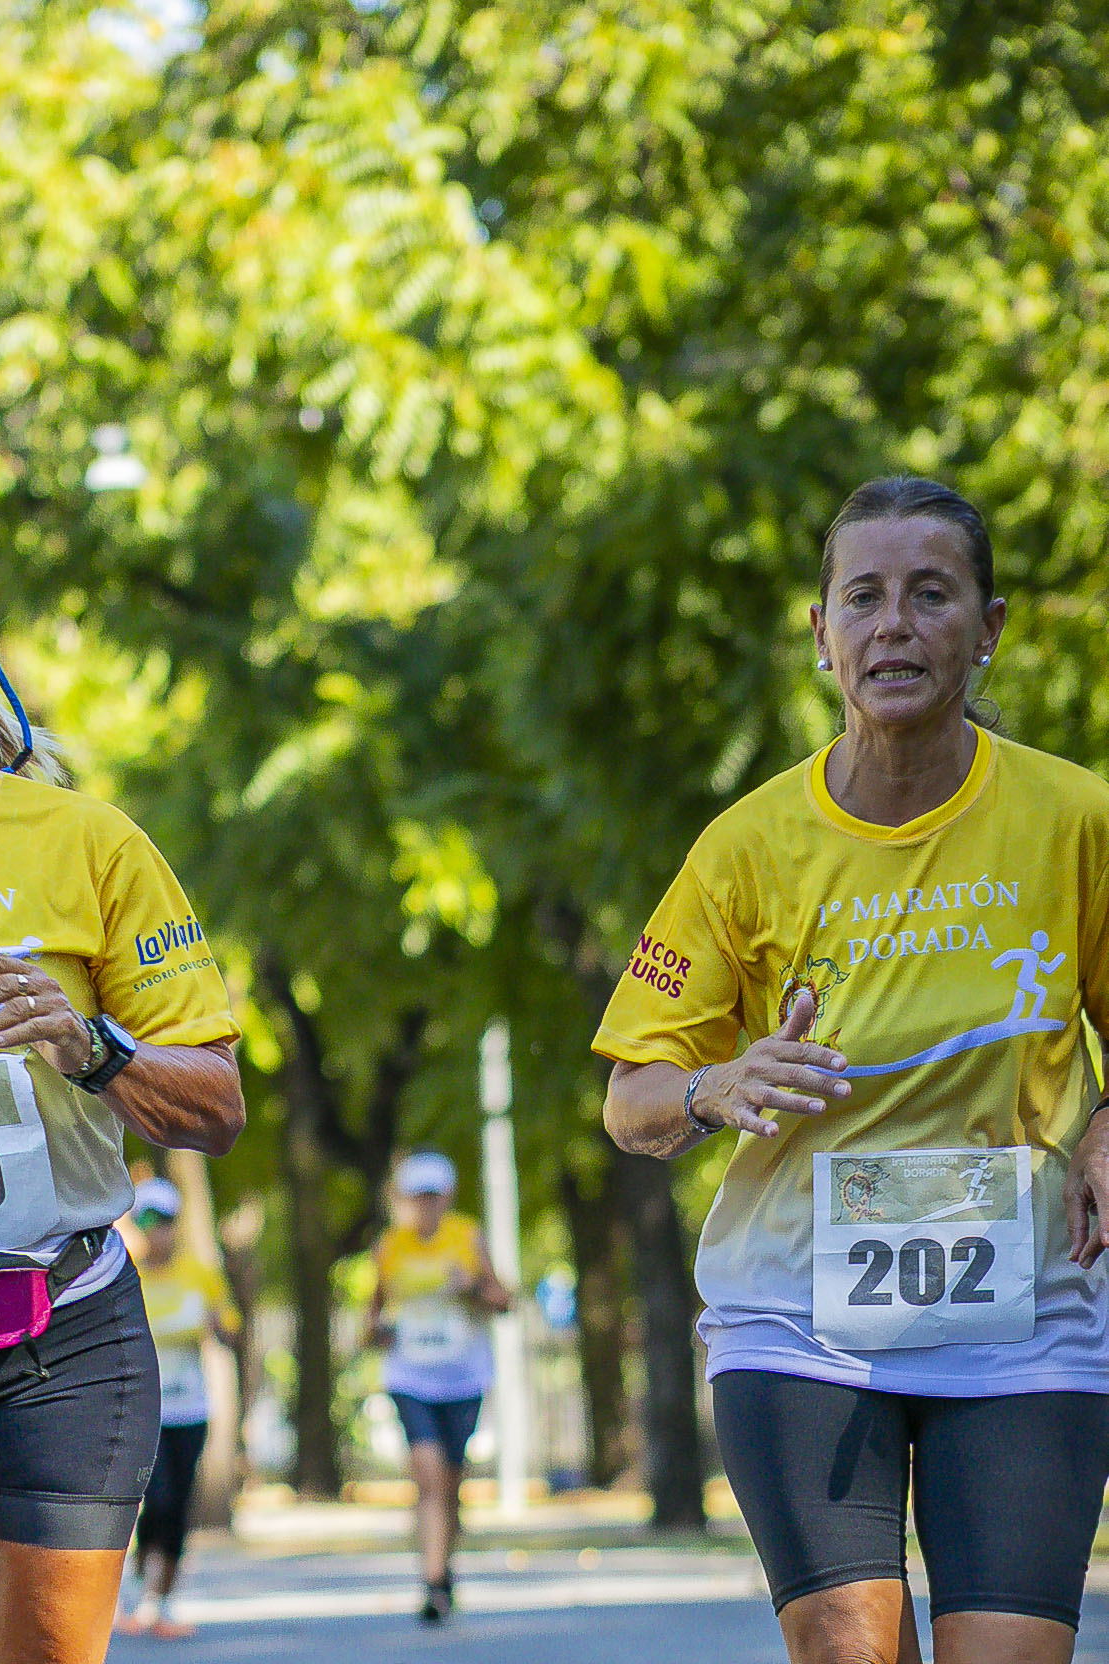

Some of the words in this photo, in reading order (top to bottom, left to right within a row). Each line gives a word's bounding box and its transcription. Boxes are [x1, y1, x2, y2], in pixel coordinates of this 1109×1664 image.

[852, 874, 1019, 922] MARATÓN
[847, 923, 992, 965] DORADA
[133, 968, 177, 993] SABORES
[848, 1236, 996, 1306] 202
